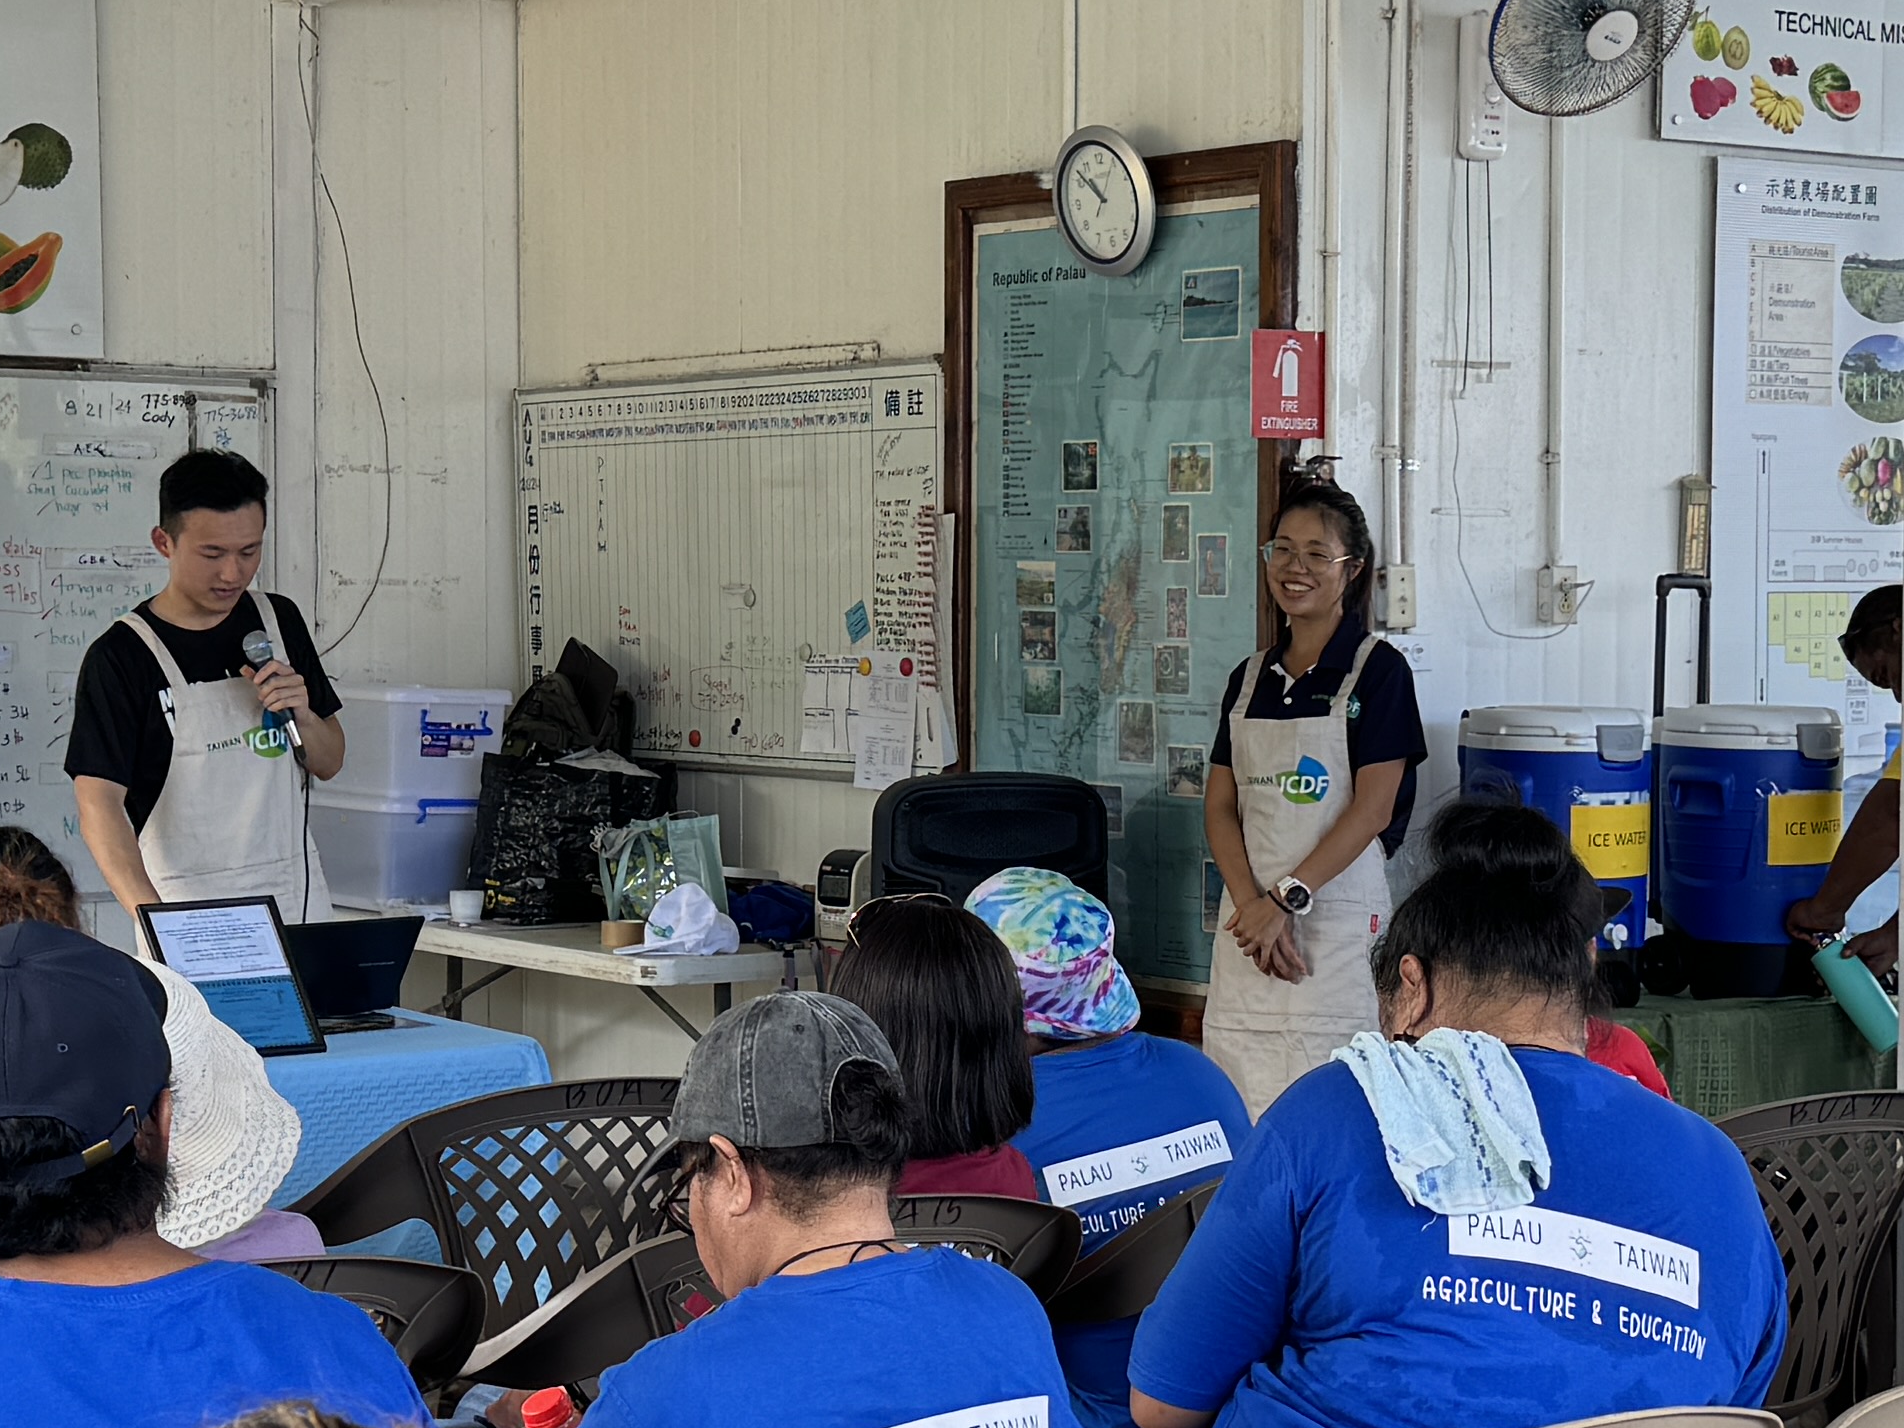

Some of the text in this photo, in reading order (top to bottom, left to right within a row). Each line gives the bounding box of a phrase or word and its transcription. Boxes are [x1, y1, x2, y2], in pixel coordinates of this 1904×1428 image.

[1774, 9, 1876, 43] TECHNICAL
[1083, 161, 1091, 173] 11
[1094, 152, 1104, 165] 12
[1765, 178, 1878, 207] 示範農場配置圖
[1075, 199, 1082, 211] 9
[1761, 204, 1801, 217] Distribution
[1803, 205, 1811, 217] of
[1811, 208, 1862, 221] Demonstration
[1083, 219, 1090, 232] 8
[1109, 235, 1116, 248] 6
[992, 264, 1087, 289] Republic of Palau
[884, 388, 924, 417] 備註
[1280, 399, 1299, 413] FIRE
[141, 411, 176, 429] Cody
[1261, 416, 1319, 431] EXTINGUISHER
[1279, 775, 1330, 794] ICDF
[1785, 818, 1841, 836] ICE WATER
[1587, 830, 1647, 848] ICE WATER
[1058, 1131, 1222, 1192] PALAU TAIWAN
[1467, 1212, 1691, 1286] PALAU TAIWAN
[1422, 1274, 1708, 1362] AGRICULTURE & EDUCATION
